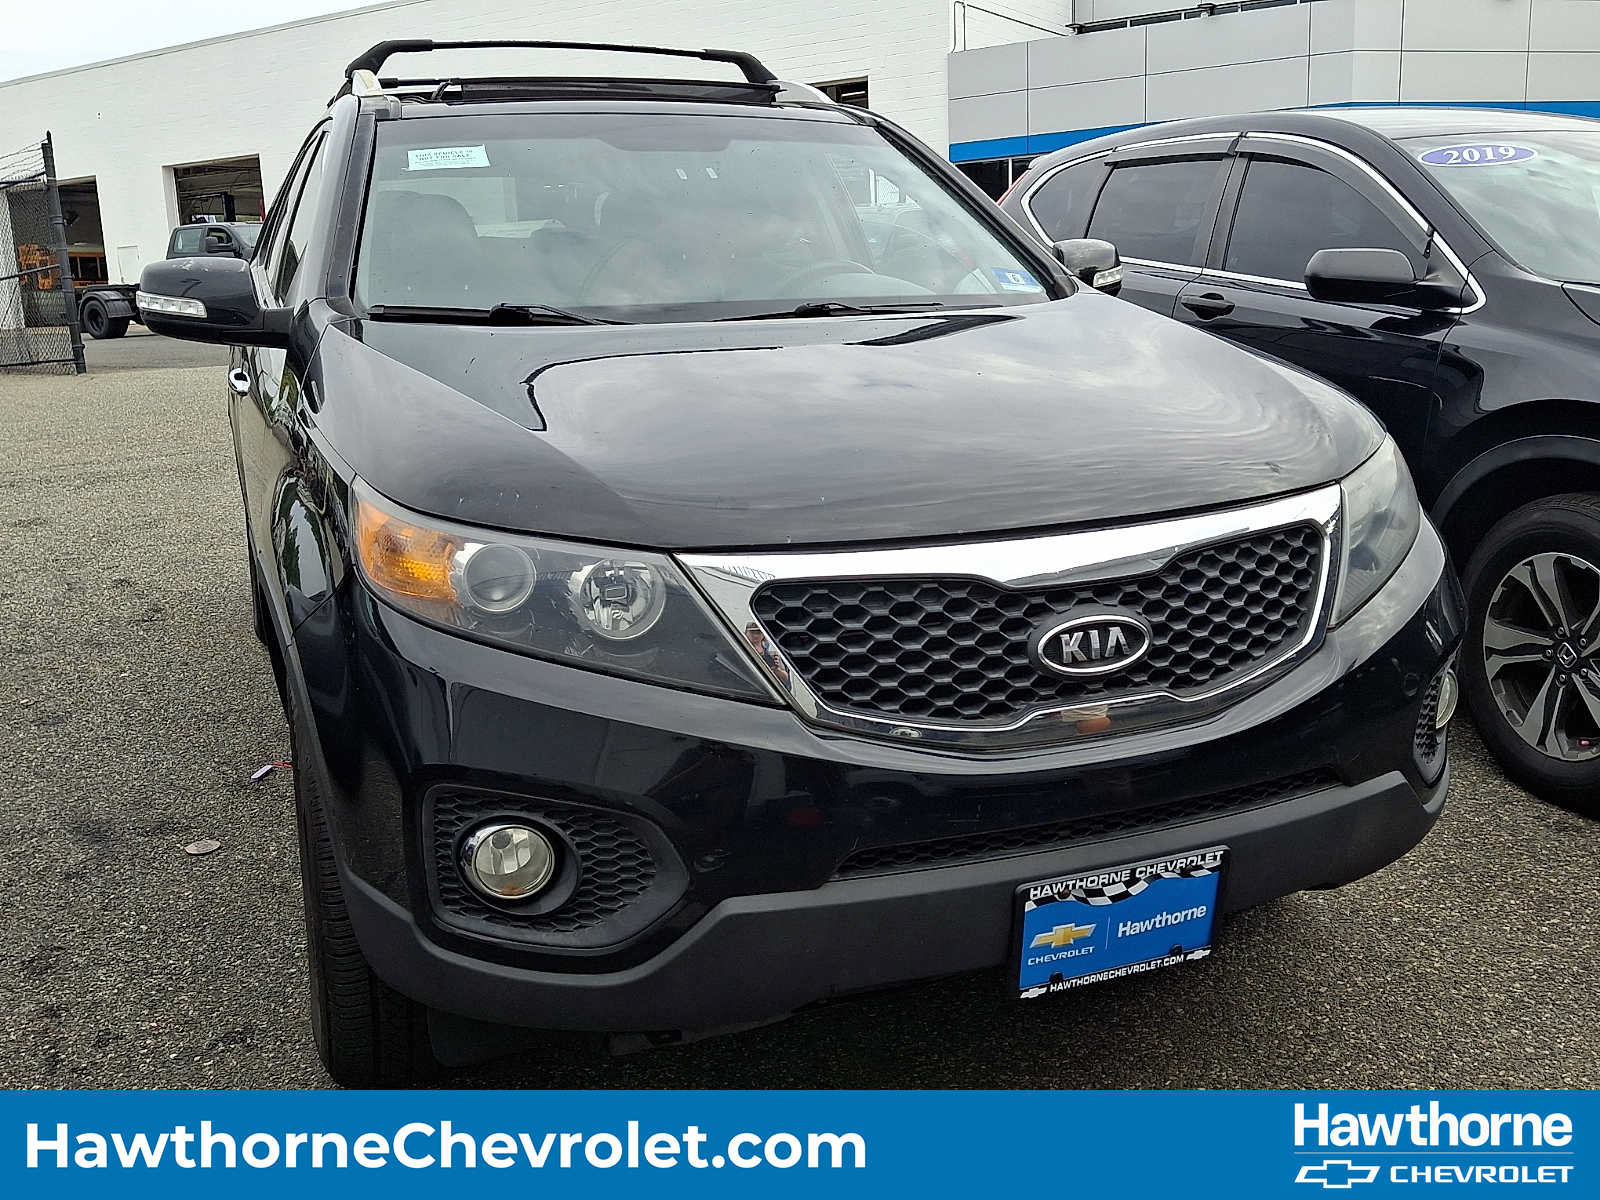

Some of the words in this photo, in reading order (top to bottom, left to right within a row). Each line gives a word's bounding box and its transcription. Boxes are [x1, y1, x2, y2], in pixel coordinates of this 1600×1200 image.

[1443, 146, 1516, 164] 2019
[1060, 626, 1130, 664] KIA
[1029, 870, 1131, 900] HAWTHORNE
[1135, 851, 1224, 878] CHEVROLET
[1117, 905, 1207, 938] Hawthorne
[1027, 946, 1096, 966] CHEVROLET
[1050, 955, 1184, 993] HAWTHORNECHEVROLET.COM
